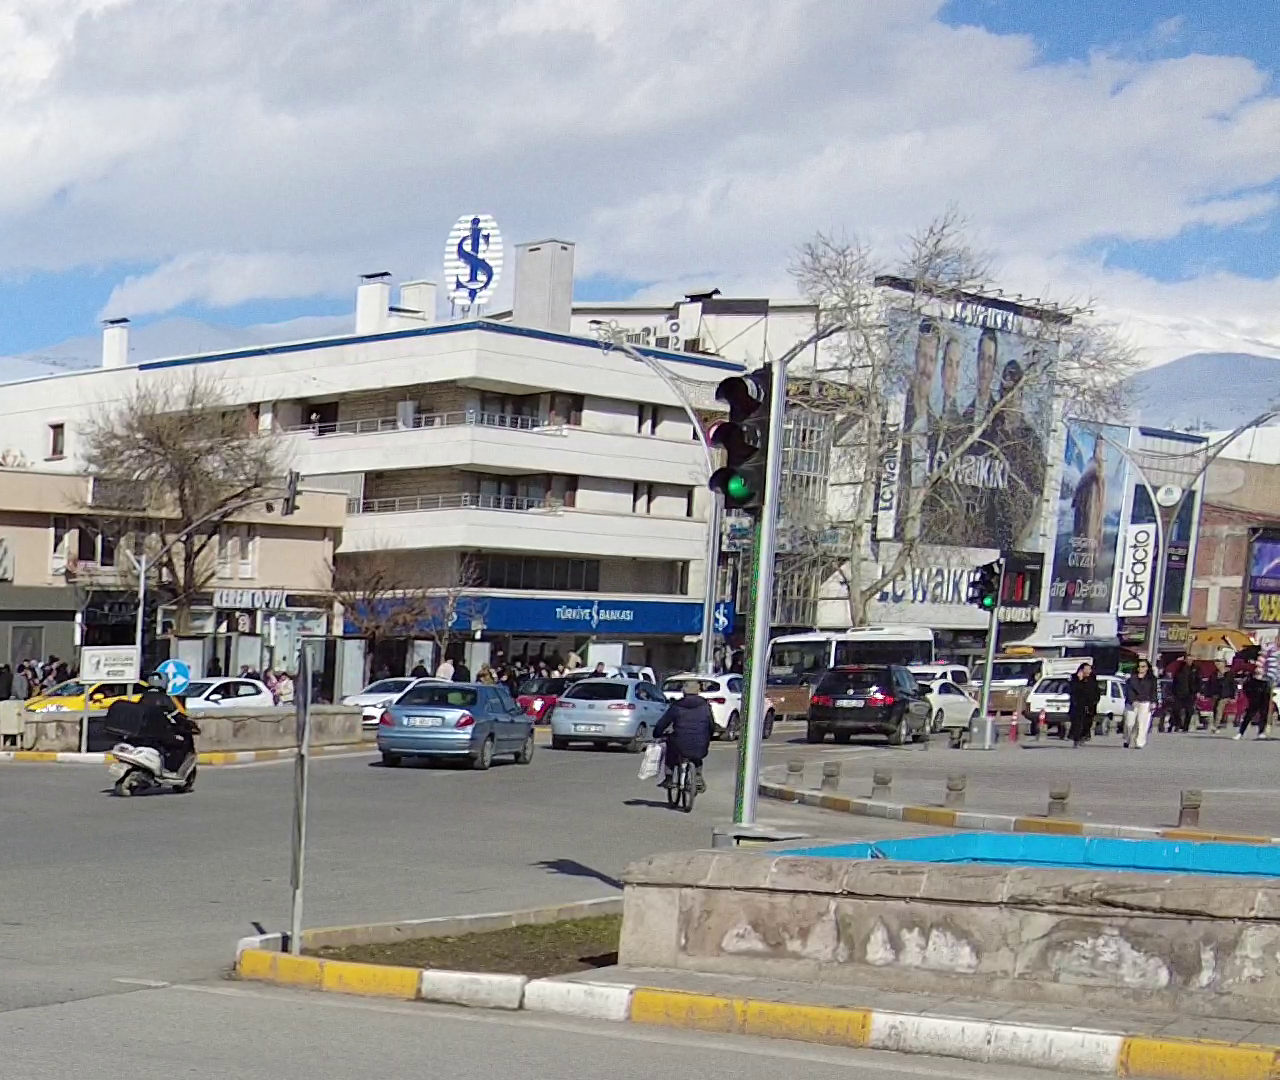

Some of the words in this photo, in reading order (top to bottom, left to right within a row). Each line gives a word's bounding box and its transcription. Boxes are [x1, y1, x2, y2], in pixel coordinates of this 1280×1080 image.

[1122, 529, 1151, 611] DeFacto
[555, 604, 591, 620] TÜRKİYE
[599, 608, 634, 621] BANKASI
